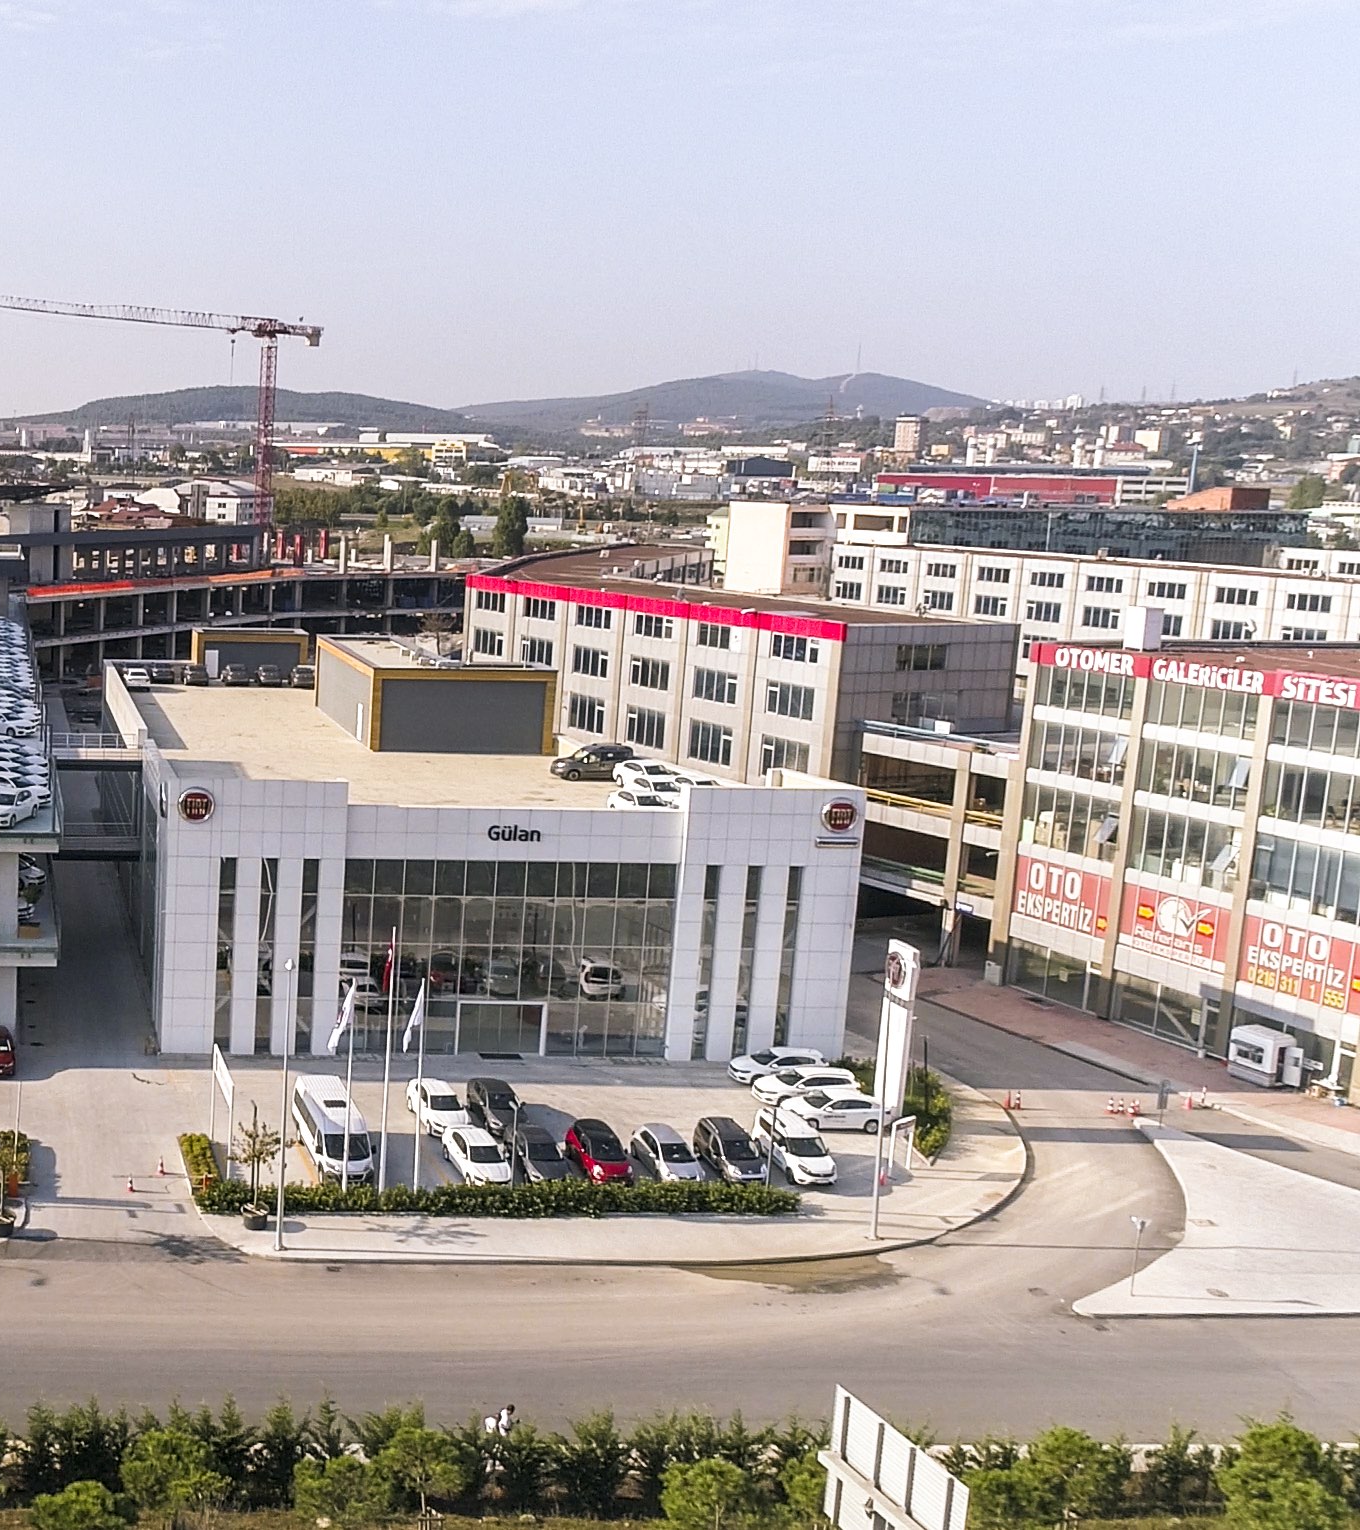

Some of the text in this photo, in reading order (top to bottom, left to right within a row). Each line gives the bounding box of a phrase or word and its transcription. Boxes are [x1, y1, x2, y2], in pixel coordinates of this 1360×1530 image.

[1055, 647, 1134, 676] OTOMER
[1281, 675, 1357, 708] SİTESİ
[487, 824, 541, 842] Gülan
[1030, 862, 1081, 900] OTO
[1017, 890, 1093, 932] EKSPERTİZ
[1135, 924, 1204, 955] Referans
[1262, 922, 1328, 961] OTO
[1247, 945, 1345, 989] EKSPERTİZ
[1257, 968, 1276, 988] 216
[1280, 975, 1299, 996] 311
[1308, 983, 1315, 1000] 1
[1324, 987, 1345, 1009] 555
